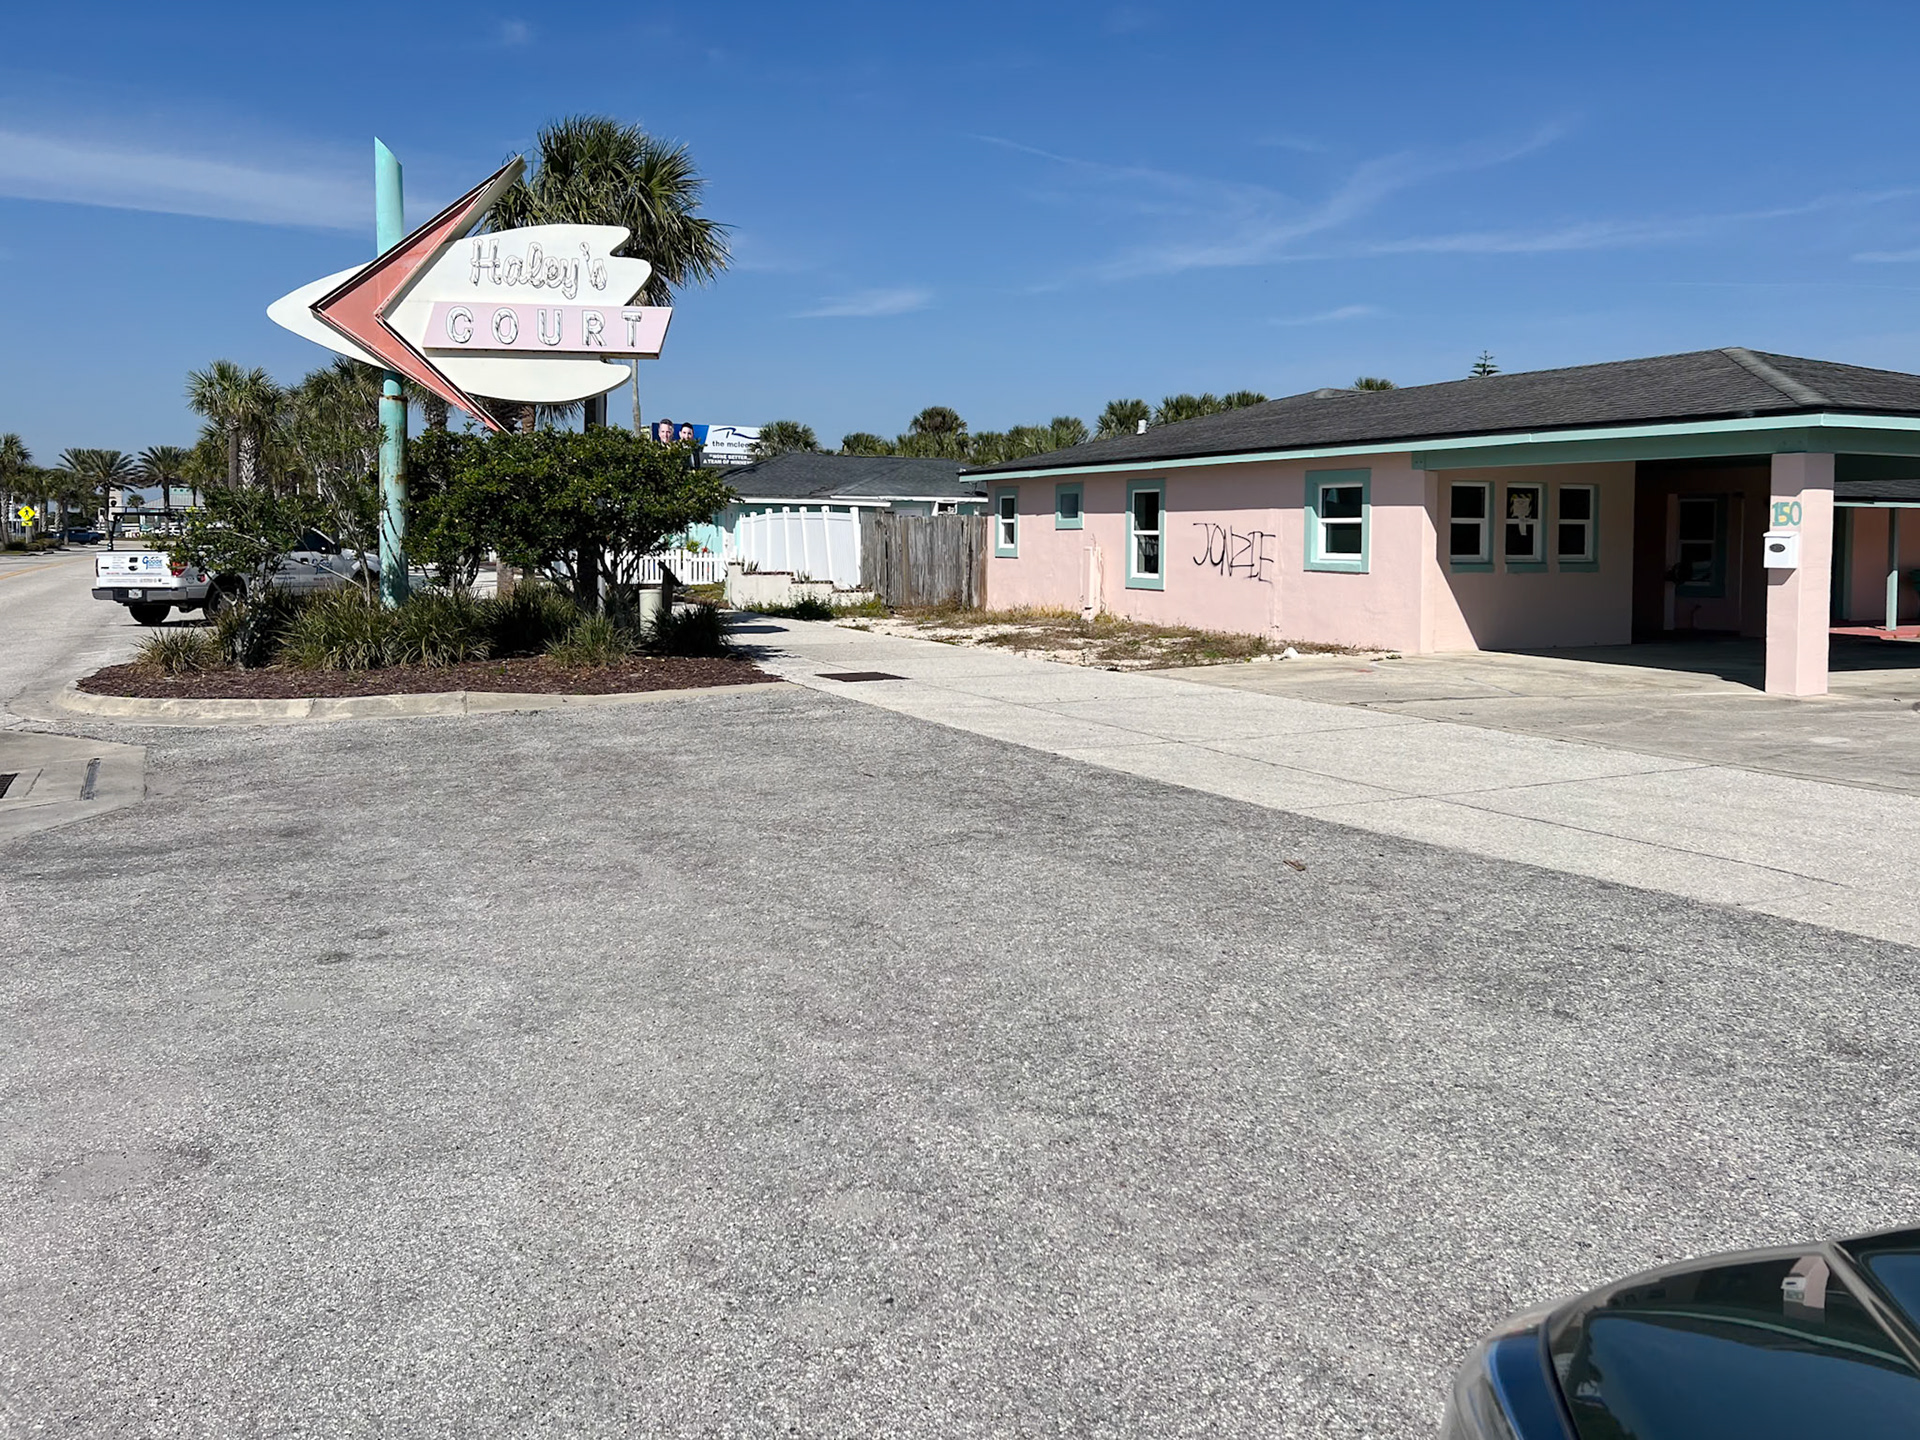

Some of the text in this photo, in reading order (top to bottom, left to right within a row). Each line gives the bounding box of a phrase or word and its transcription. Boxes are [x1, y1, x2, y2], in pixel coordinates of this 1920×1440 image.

[469, 238, 608, 300] Haley's
[446, 306, 642, 348] COURT
[1771, 501, 1802, 526] 150
